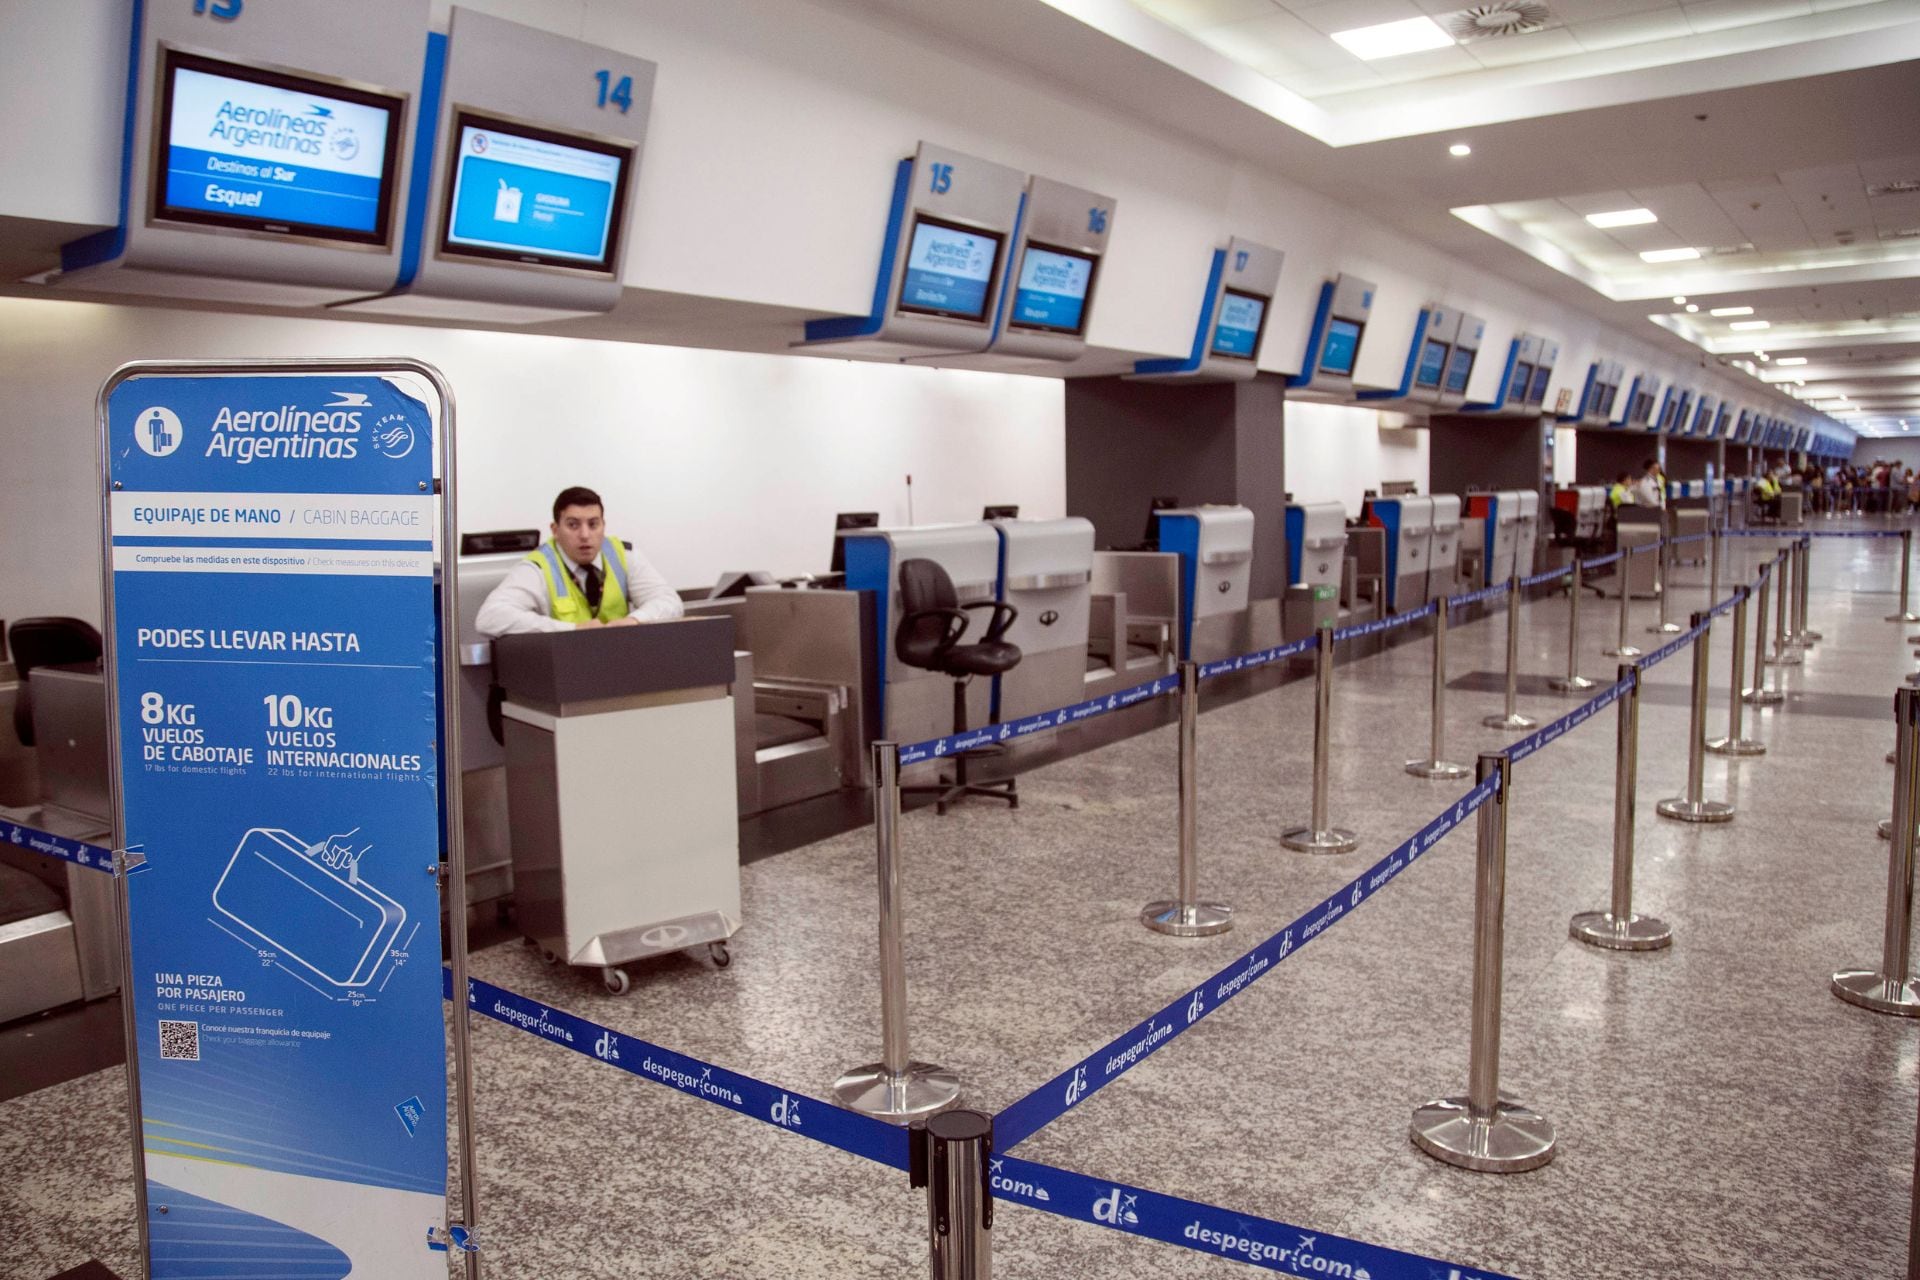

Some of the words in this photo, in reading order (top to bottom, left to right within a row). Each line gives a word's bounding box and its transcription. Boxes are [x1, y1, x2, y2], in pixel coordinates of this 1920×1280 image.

[594, 70, 633, 113] 14
[215, 100, 327, 138] Aerolíneas
[209, 121, 322, 156] Argentinas
[207, 156, 259, 178] Destinos
[273, 167, 297, 182] Sur
[930, 162, 954, 194] 15
[204, 184, 263, 208] Esquel
[211, 405, 363, 433] Aerolíneas
[372, 414, 405, 449] SKYTEAM
[205, 432, 359, 464] Argentinas
[134, 507, 205, 525] EQUIPAJE
[210, 508, 230, 523] DE
[235, 509, 281, 524] MANO
[289, 509, 296, 524] /
[303, 509, 347, 525] CABIN
[350, 510, 420, 526] BAGGAGE
[135, 554, 181, 564] Compruebe
[183, 555, 194, 563] las
[196, 555, 229, 564] medidas
[243, 557, 260, 565] este
[262, 556, 305, 566] dispositivo
[312, 557, 336, 566] Check
[336, 558, 369, 567] measures
[382, 558, 395, 567] this
[396, 559, 419, 568] device
[138, 628, 205, 649] PODES
[210, 629, 286, 650] LLEVAR
[291, 631, 361, 653] HASTA
[142, 727, 205, 744] VUELOS
[266, 730, 336, 748] VUELOS
[144, 745, 165, 761] DE
[171, 746, 254, 766] CABOTAJE
[267, 750, 421, 771] INTERNACIONALES
[144, 764, 153, 772] 17
[154, 764, 166, 772] lbs
[167, 764, 179, 772] for
[182, 766, 218, 774] domestic
[220, 766, 247, 776] flights
[267, 768, 278, 776] 22
[281, 769, 295, 777] lbs
[298, 769, 313, 777] for
[316, 770, 383, 780] international
[386, 773, 421, 783] flights
[155, 973, 184, 985] UNA
[187, 974, 223, 987] PIEZA
[157, 987, 182, 999] POR
[185, 988, 246, 1003] PASAJERO
[158, 1003, 178, 1011] ONE
[179, 1004, 206, 1013] PIECE
[208, 1005, 226, 1014] PER
[229, 1006, 284, 1017] PASSENGER
[201, 1023, 227, 1032] Conocé
[227, 1025, 254, 1034] nuestra
[255, 1026, 290, 1036] franquicia
[290, 1028, 300, 1037] de
[301, 1029, 331, 1040] equipaje
